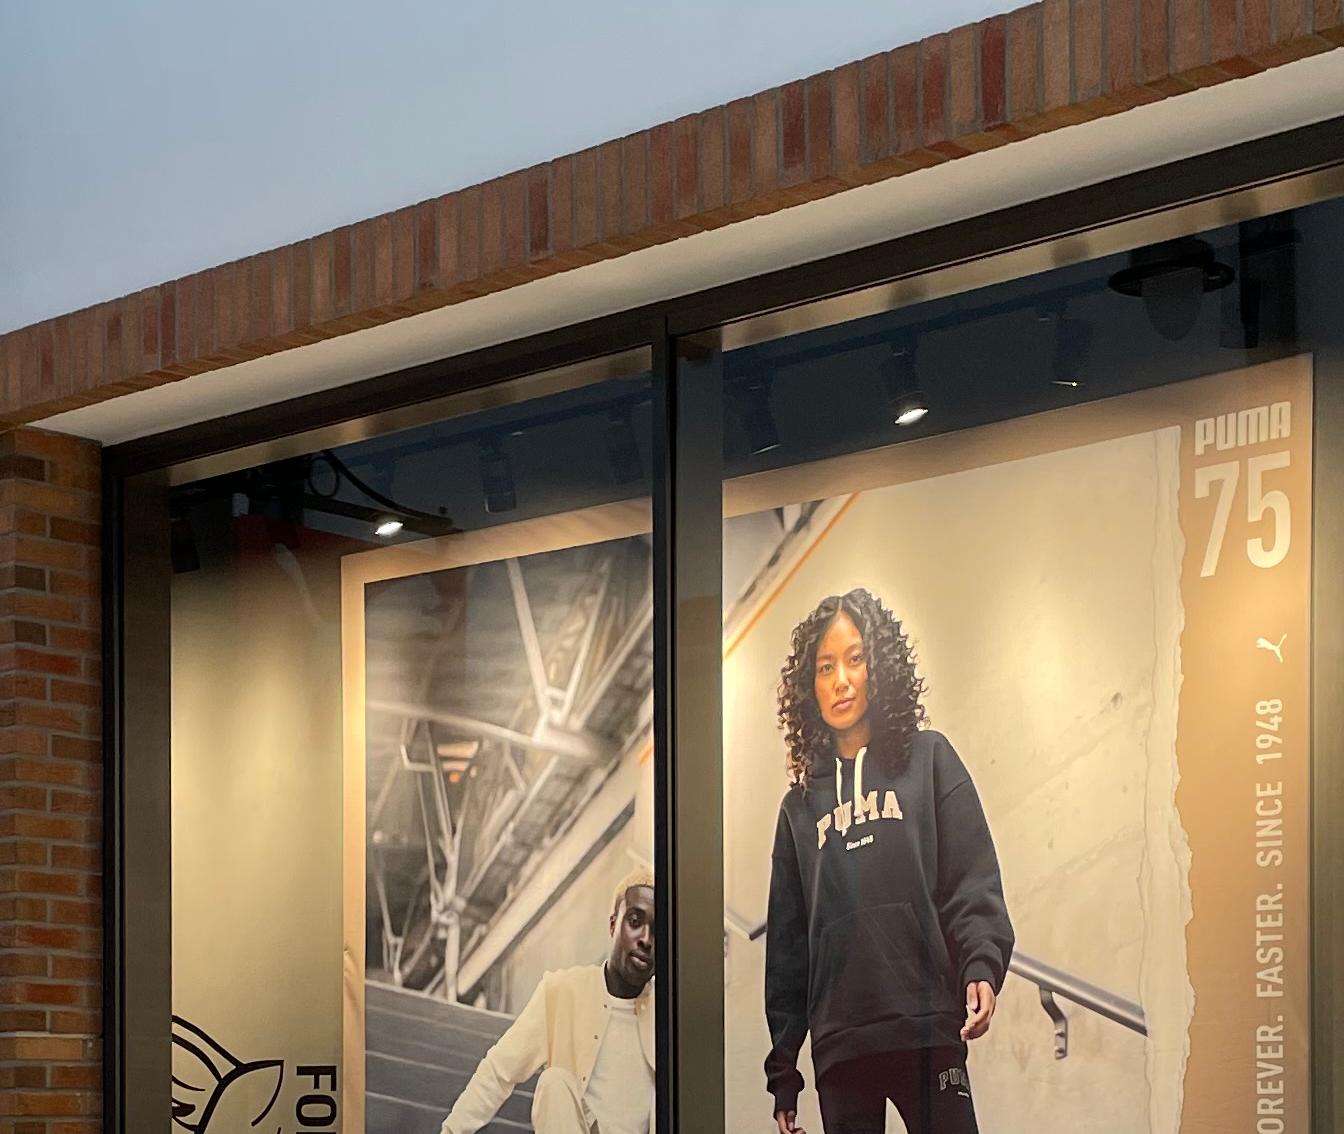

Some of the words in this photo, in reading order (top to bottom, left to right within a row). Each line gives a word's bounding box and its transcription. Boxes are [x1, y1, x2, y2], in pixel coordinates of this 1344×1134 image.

[1195, 401, 1291, 456] PUMA
[1194, 450, 1292, 577] 75
[1255, 698, 1283, 765] 1948
[816, 790, 903, 850] PUMA
[1255, 781, 1283, 868] SINCE
[1256, 883, 1284, 998] FASTER.
